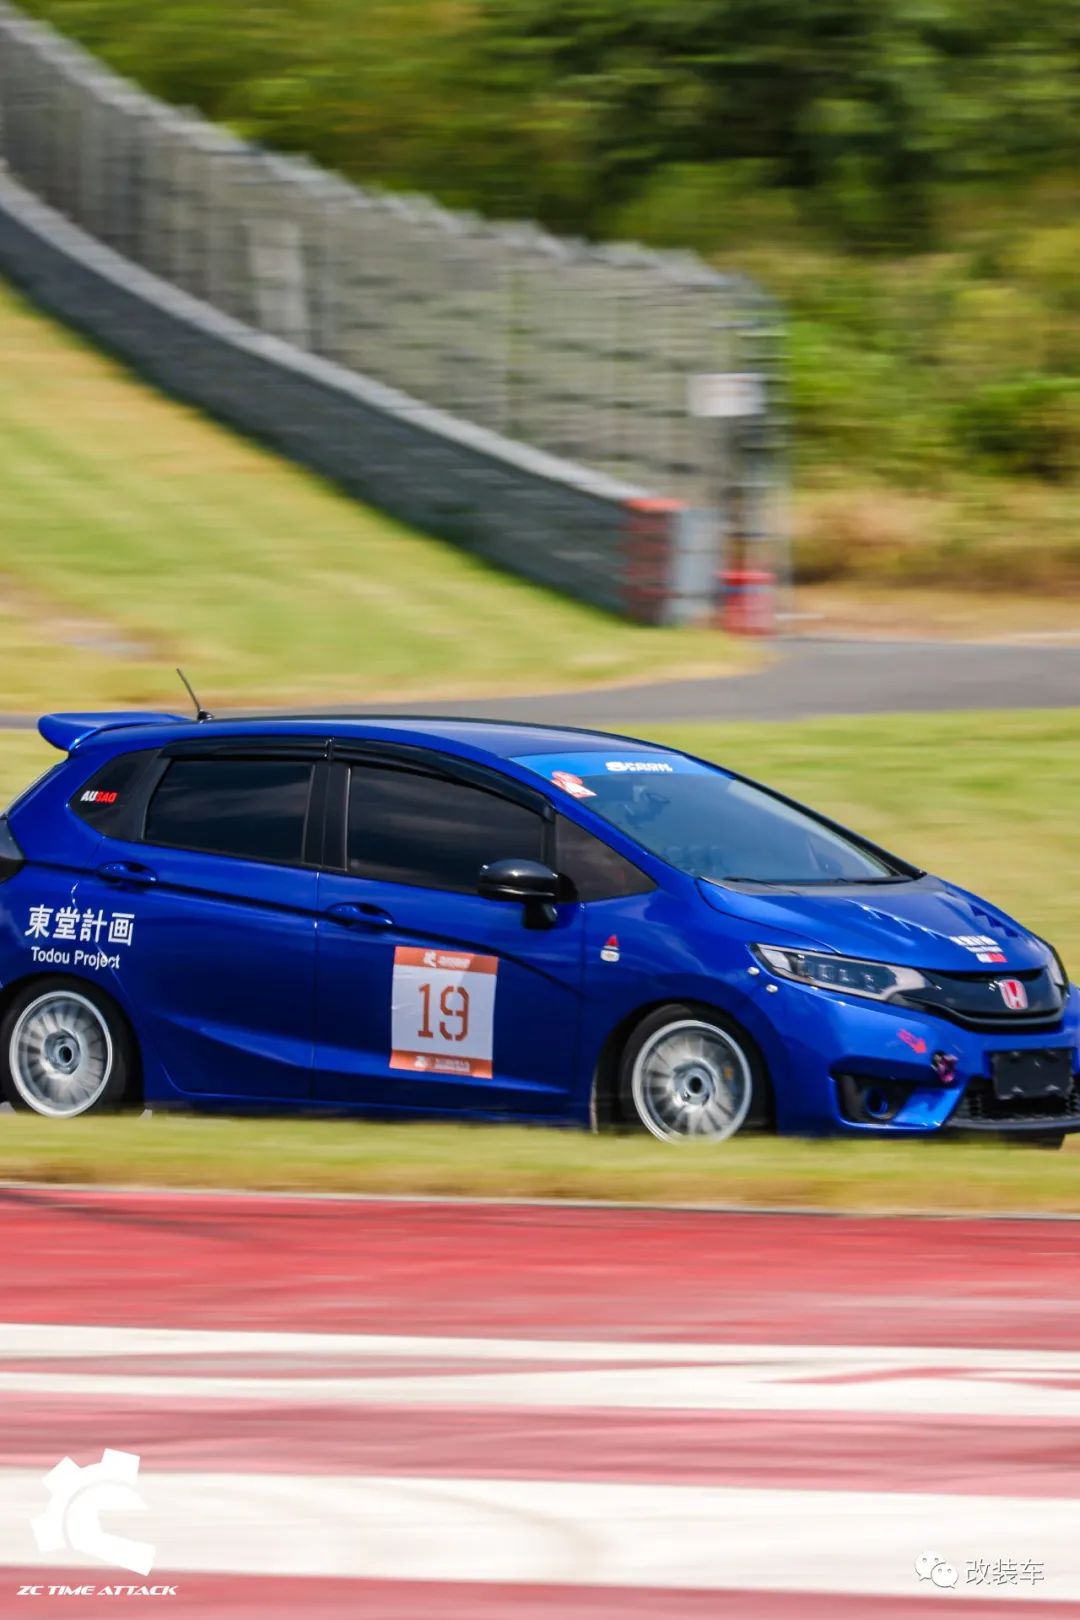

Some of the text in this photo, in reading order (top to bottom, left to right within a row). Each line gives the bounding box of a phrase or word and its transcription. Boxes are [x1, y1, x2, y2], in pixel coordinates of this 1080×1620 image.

[24, 904, 135, 946] 東堂計画
[31, 946, 120, 970] Todou Project
[417, 983, 470, 1042] 19
